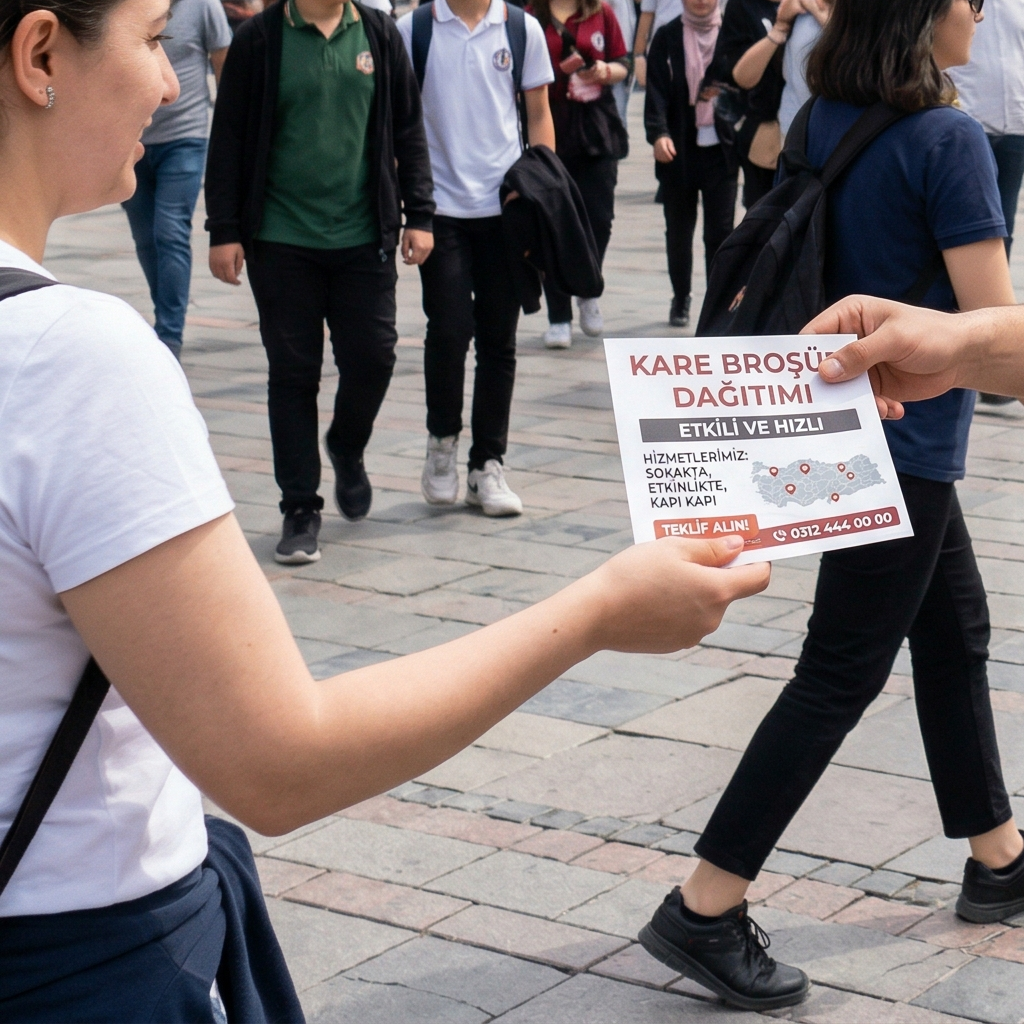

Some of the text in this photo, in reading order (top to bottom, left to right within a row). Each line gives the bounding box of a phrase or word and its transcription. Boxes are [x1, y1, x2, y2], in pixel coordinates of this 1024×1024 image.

[629, 346, 836, 379] KARE BROŞÜ
[673, 380, 813, 408] DAĞITIMI
[679, 417, 824, 438] ETKİLİ VE HIZLI
[643, 447, 749, 465] HİZMETLERİMİZ:
[645, 466, 712, 479] SOKAKTA,
[648, 479, 727, 494] ETKİNLİKTE,
[650, 495, 717, 508] KAPI KAPI
[661, 519, 750, 536] TEKLİF ALIN!
[823, 519, 851, 534] 444
[853, 516, 872, 529] 00
[874, 512, 892, 525] 00
